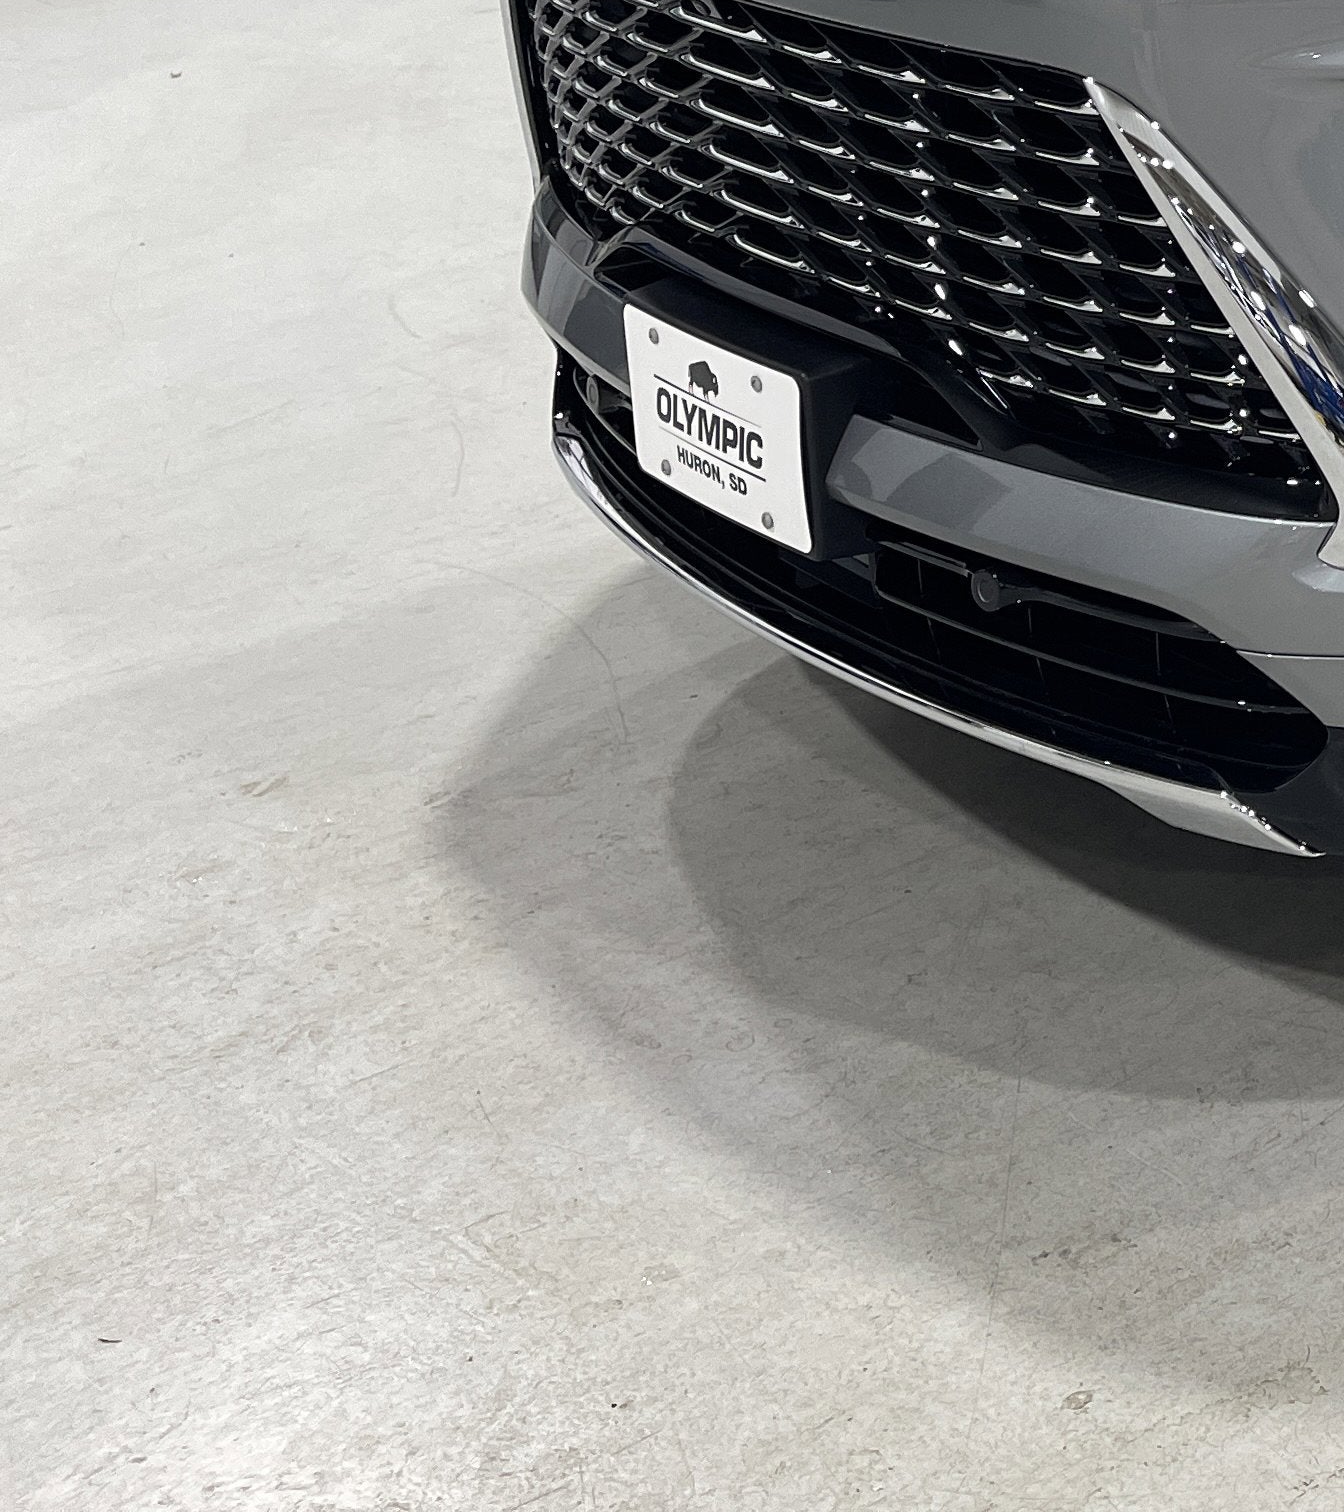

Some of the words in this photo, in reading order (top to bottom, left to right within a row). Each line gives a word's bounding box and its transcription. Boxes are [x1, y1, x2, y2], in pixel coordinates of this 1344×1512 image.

[656, 387, 763, 470] OLYMPIC
[676, 444, 725, 489] HURON,
[728, 471, 748, 496] SD
